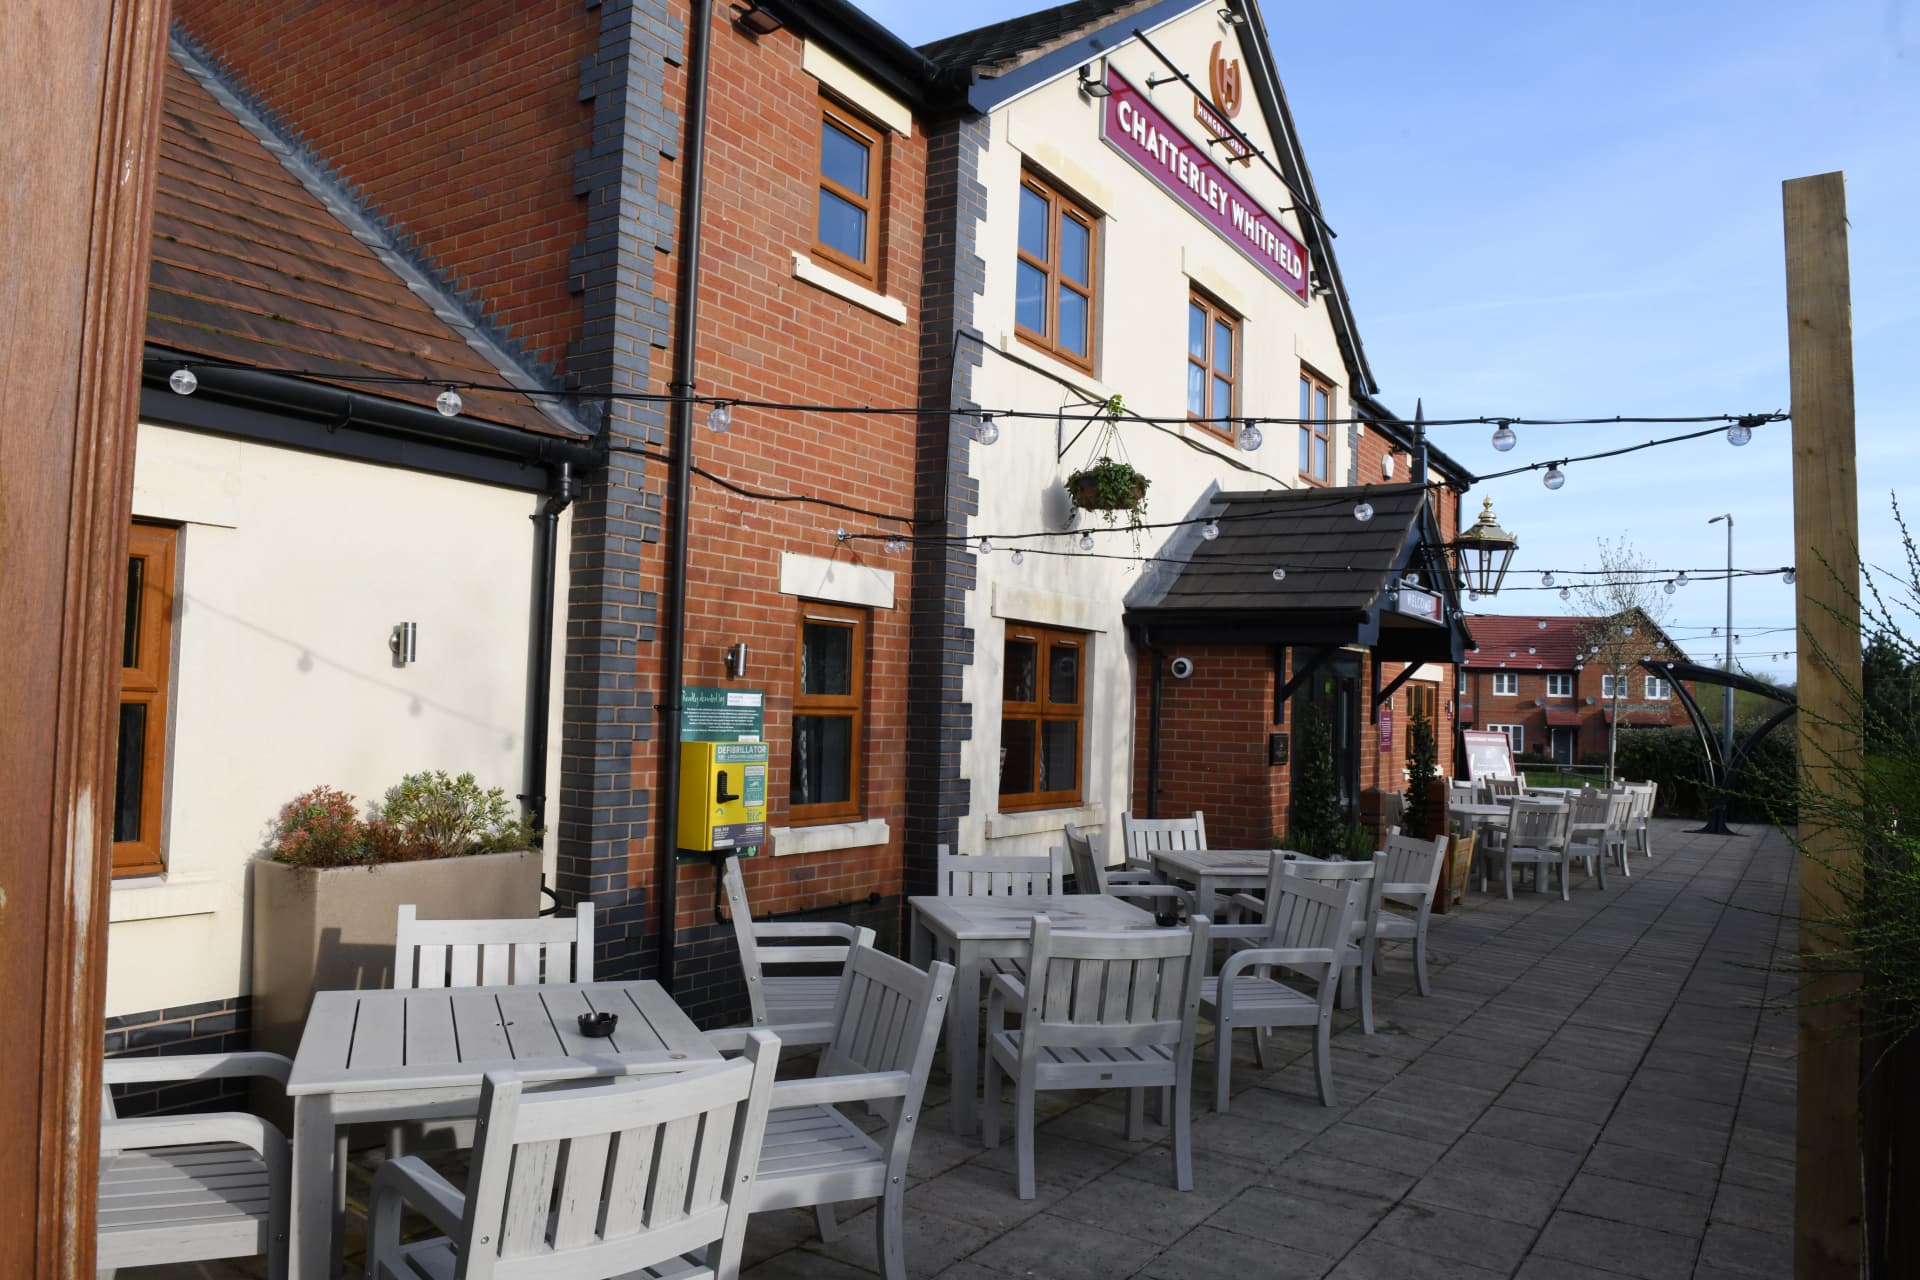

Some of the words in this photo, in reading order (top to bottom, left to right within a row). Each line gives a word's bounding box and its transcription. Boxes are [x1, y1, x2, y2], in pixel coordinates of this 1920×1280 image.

[1198, 105, 1225, 138] HUNGRY
[1117, 100, 1228, 216] CHATTERLEY
[1232, 199, 1302, 280] WHITFIELD
[1407, 592, 1432, 612] WELCOME
[717, 745, 767, 754] DEFIBRILLATOR
